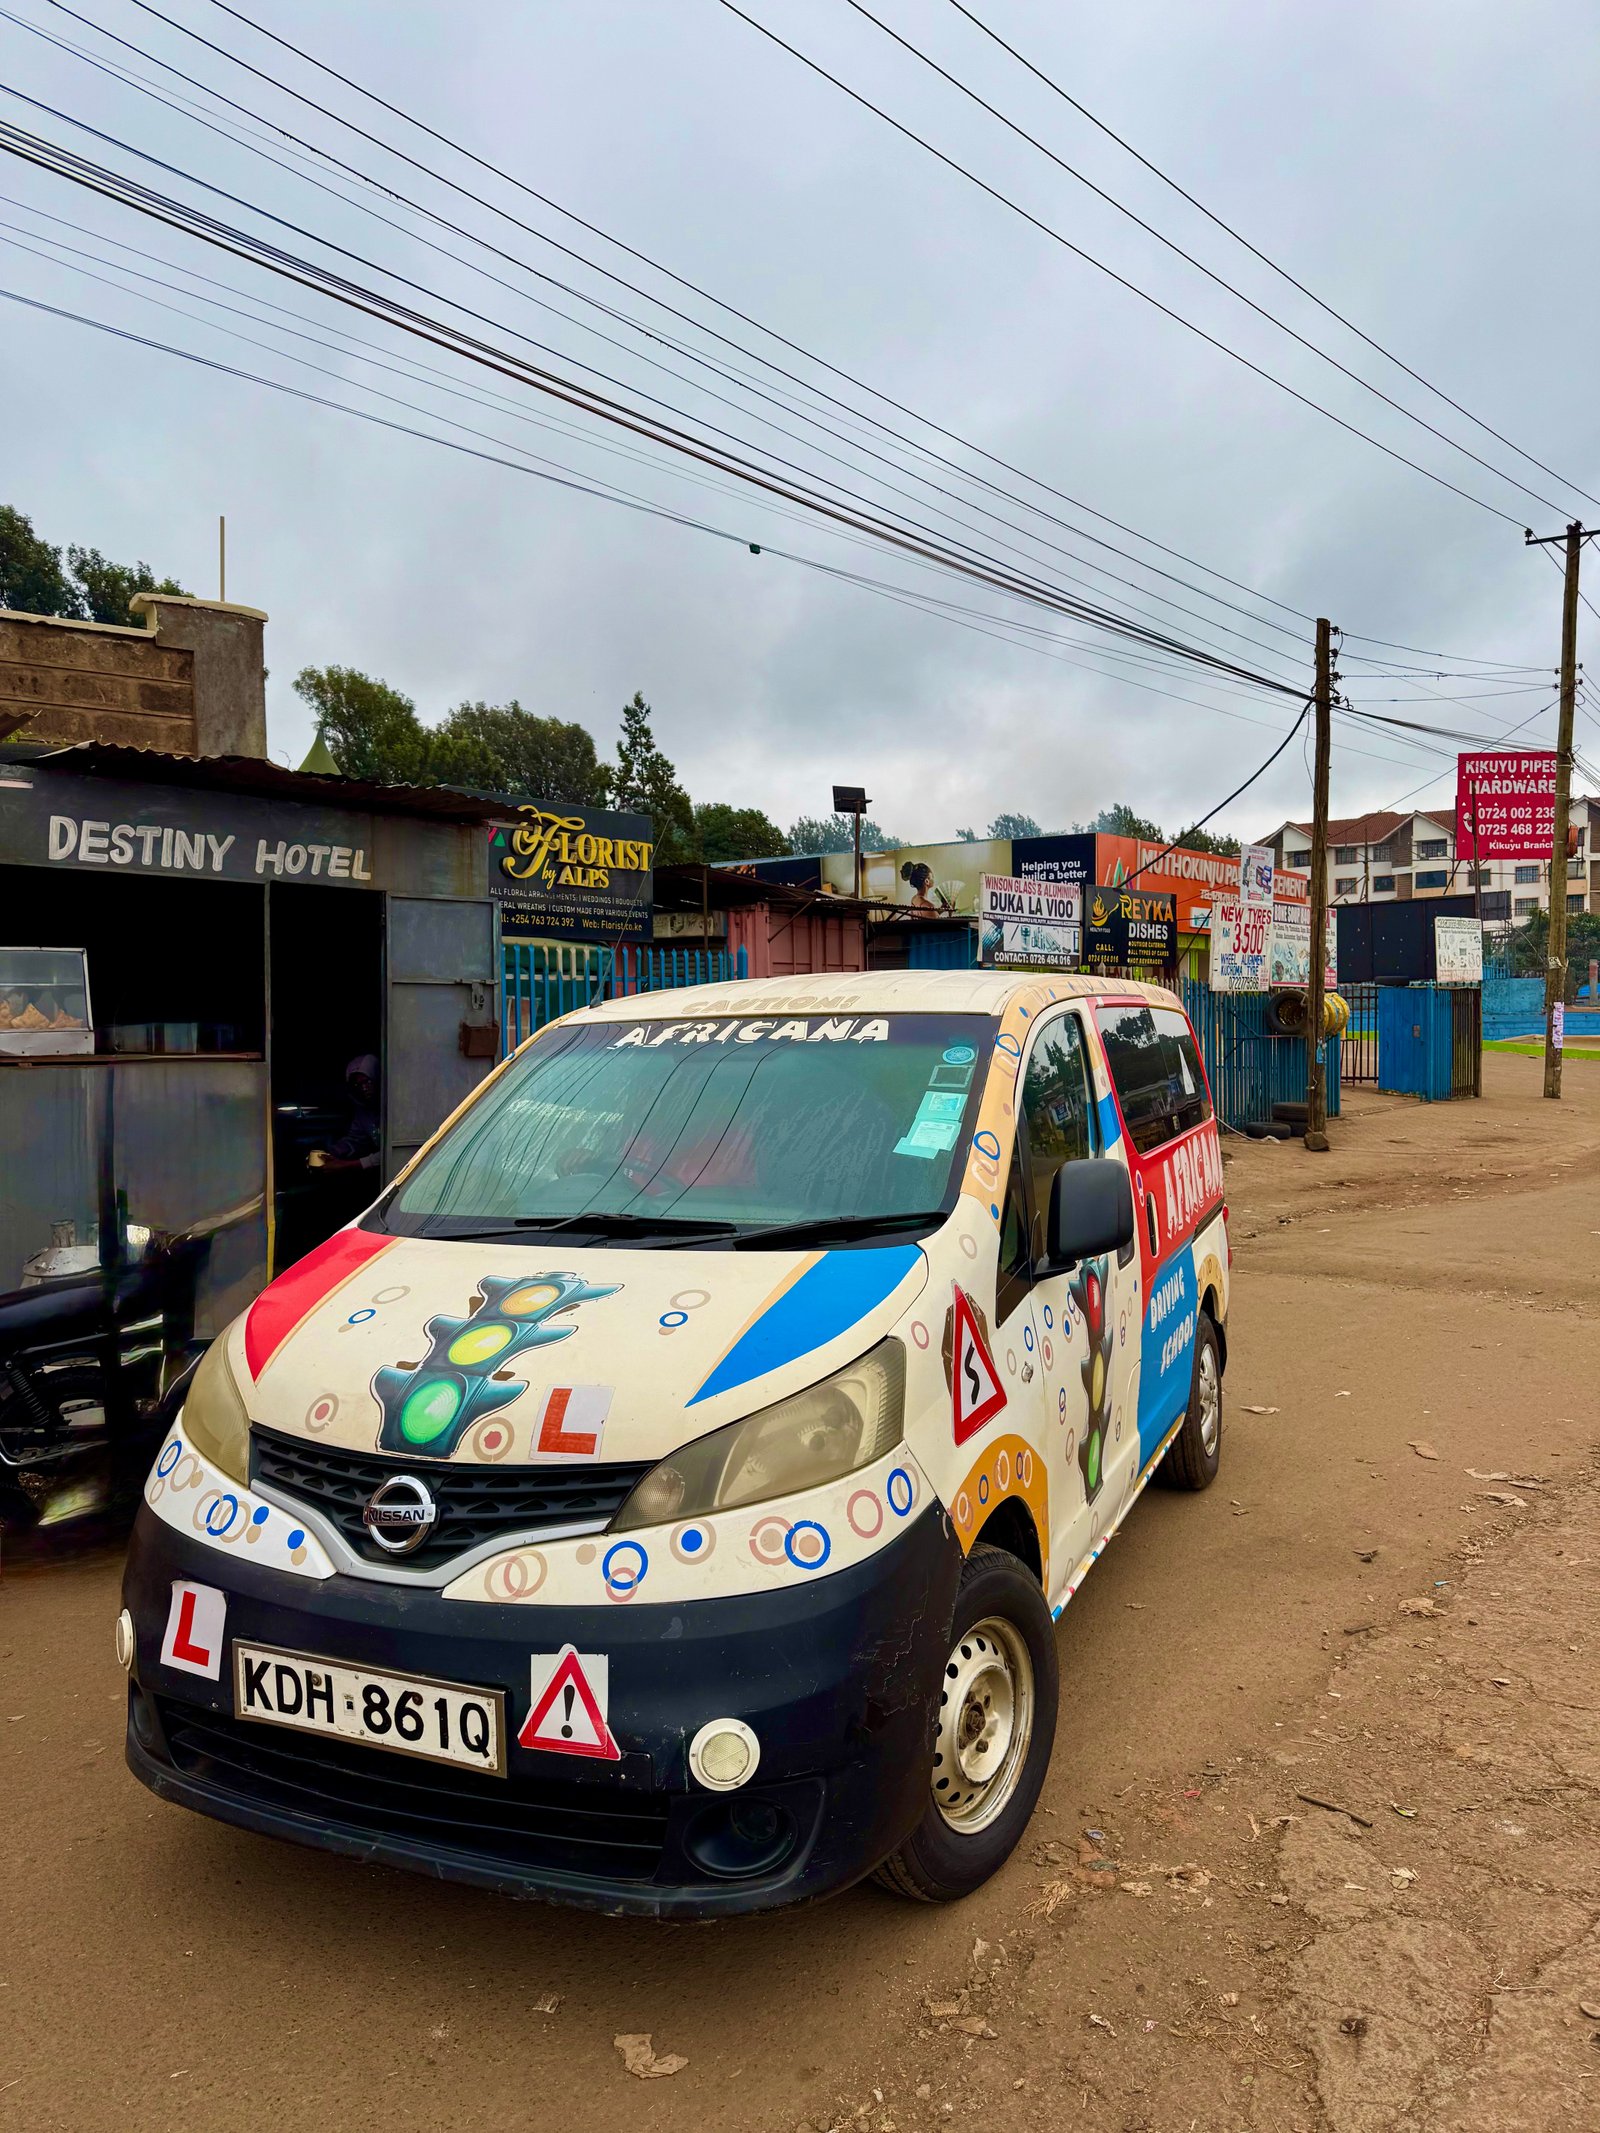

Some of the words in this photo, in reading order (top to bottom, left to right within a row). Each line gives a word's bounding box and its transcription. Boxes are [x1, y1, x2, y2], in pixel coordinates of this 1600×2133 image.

[1465, 760, 1517, 774] KIKUYU
[1521, 760, 1557, 773] PIPES
[1469, 779, 1557, 795] HARDWARE
[1478, 807, 1507, 819] 0724
[1510, 807, 1532, 819] 002
[1478, 824, 1507, 836] 0725
[1510, 823, 1532, 835] 468
[48, 815, 235, 872] DESTINY
[255, 839, 371, 880] HOTEL
[502, 805, 654, 879] FLORIST
[1489, 841, 1521, 851] Kikuyu
[1523, 841, 1554, 849] Branch
[541, 858, 557, 890] by
[557, 865, 610, 889] ALPS
[1021, 861, 1059, 872] Helping
[1061, 860, 1081, 870] you
[1021, 871, 1047, 881] build
[1057, 870, 1088, 879] better
[1141, 848, 1225, 888] MUTHOKINJU
[1273, 874, 1307, 900] CEMENT
[490, 887, 502, 895] ALL
[503, 888, 528, 898] FLORAL
[582, 895, 611, 904] WEDDINGS
[616, 898, 643, 907] BOUQUETS
[984, 875, 1013, 893] WINSON
[1014, 879, 1037, 896] GLASS
[1037, 883, 1043, 896] &
[1043, 884, 1080, 900] ALUMINIUM
[517, 902, 546, 911] WREATHS
[552, 904, 576, 913] CUSTOM
[576, 906, 592, 915] MADE
[593, 908, 605, 916] FOR
[605, 909, 628, 918] VARIOUS
[990, 891, 1024, 914] DUKA
[1029, 896, 1043, 916] LA
[1119, 894, 1174, 922] REYKA
[511, 914, 530, 924] +254
[531, 915, 545, 925] 763
[546, 916, 560, 926] 724
[561, 917, 575, 927] 392
[582, 918, 600, 928] Web:
[1220, 905, 1244, 923] NEW
[1248, 907, 1272, 925] TYRES
[1128, 922, 1168, 940] DISHES
[1232, 923, 1265, 955] 3500
[1095, 943, 1114, 952] CALL:
[994, 952, 1028, 963] CONTACT:
[1046, 955, 1059, 964] 494
[1220, 953, 1238, 965] WHEEL
[681, 995, 862, 1016] CAUTION!
[607, 1018, 890, 1050] AFRICANA
[1150, 1266, 1185, 1333] DRIVING
[1160, 1310, 1194, 1377] SCHOOL
[536, 1388, 598, 1455] L
[367, 1507, 426, 1524] NISSAN
[171, 1591, 210, 1668] L
[243, 1656, 334, 1725] KDH
[362, 1683, 491, 1758] 861Q
